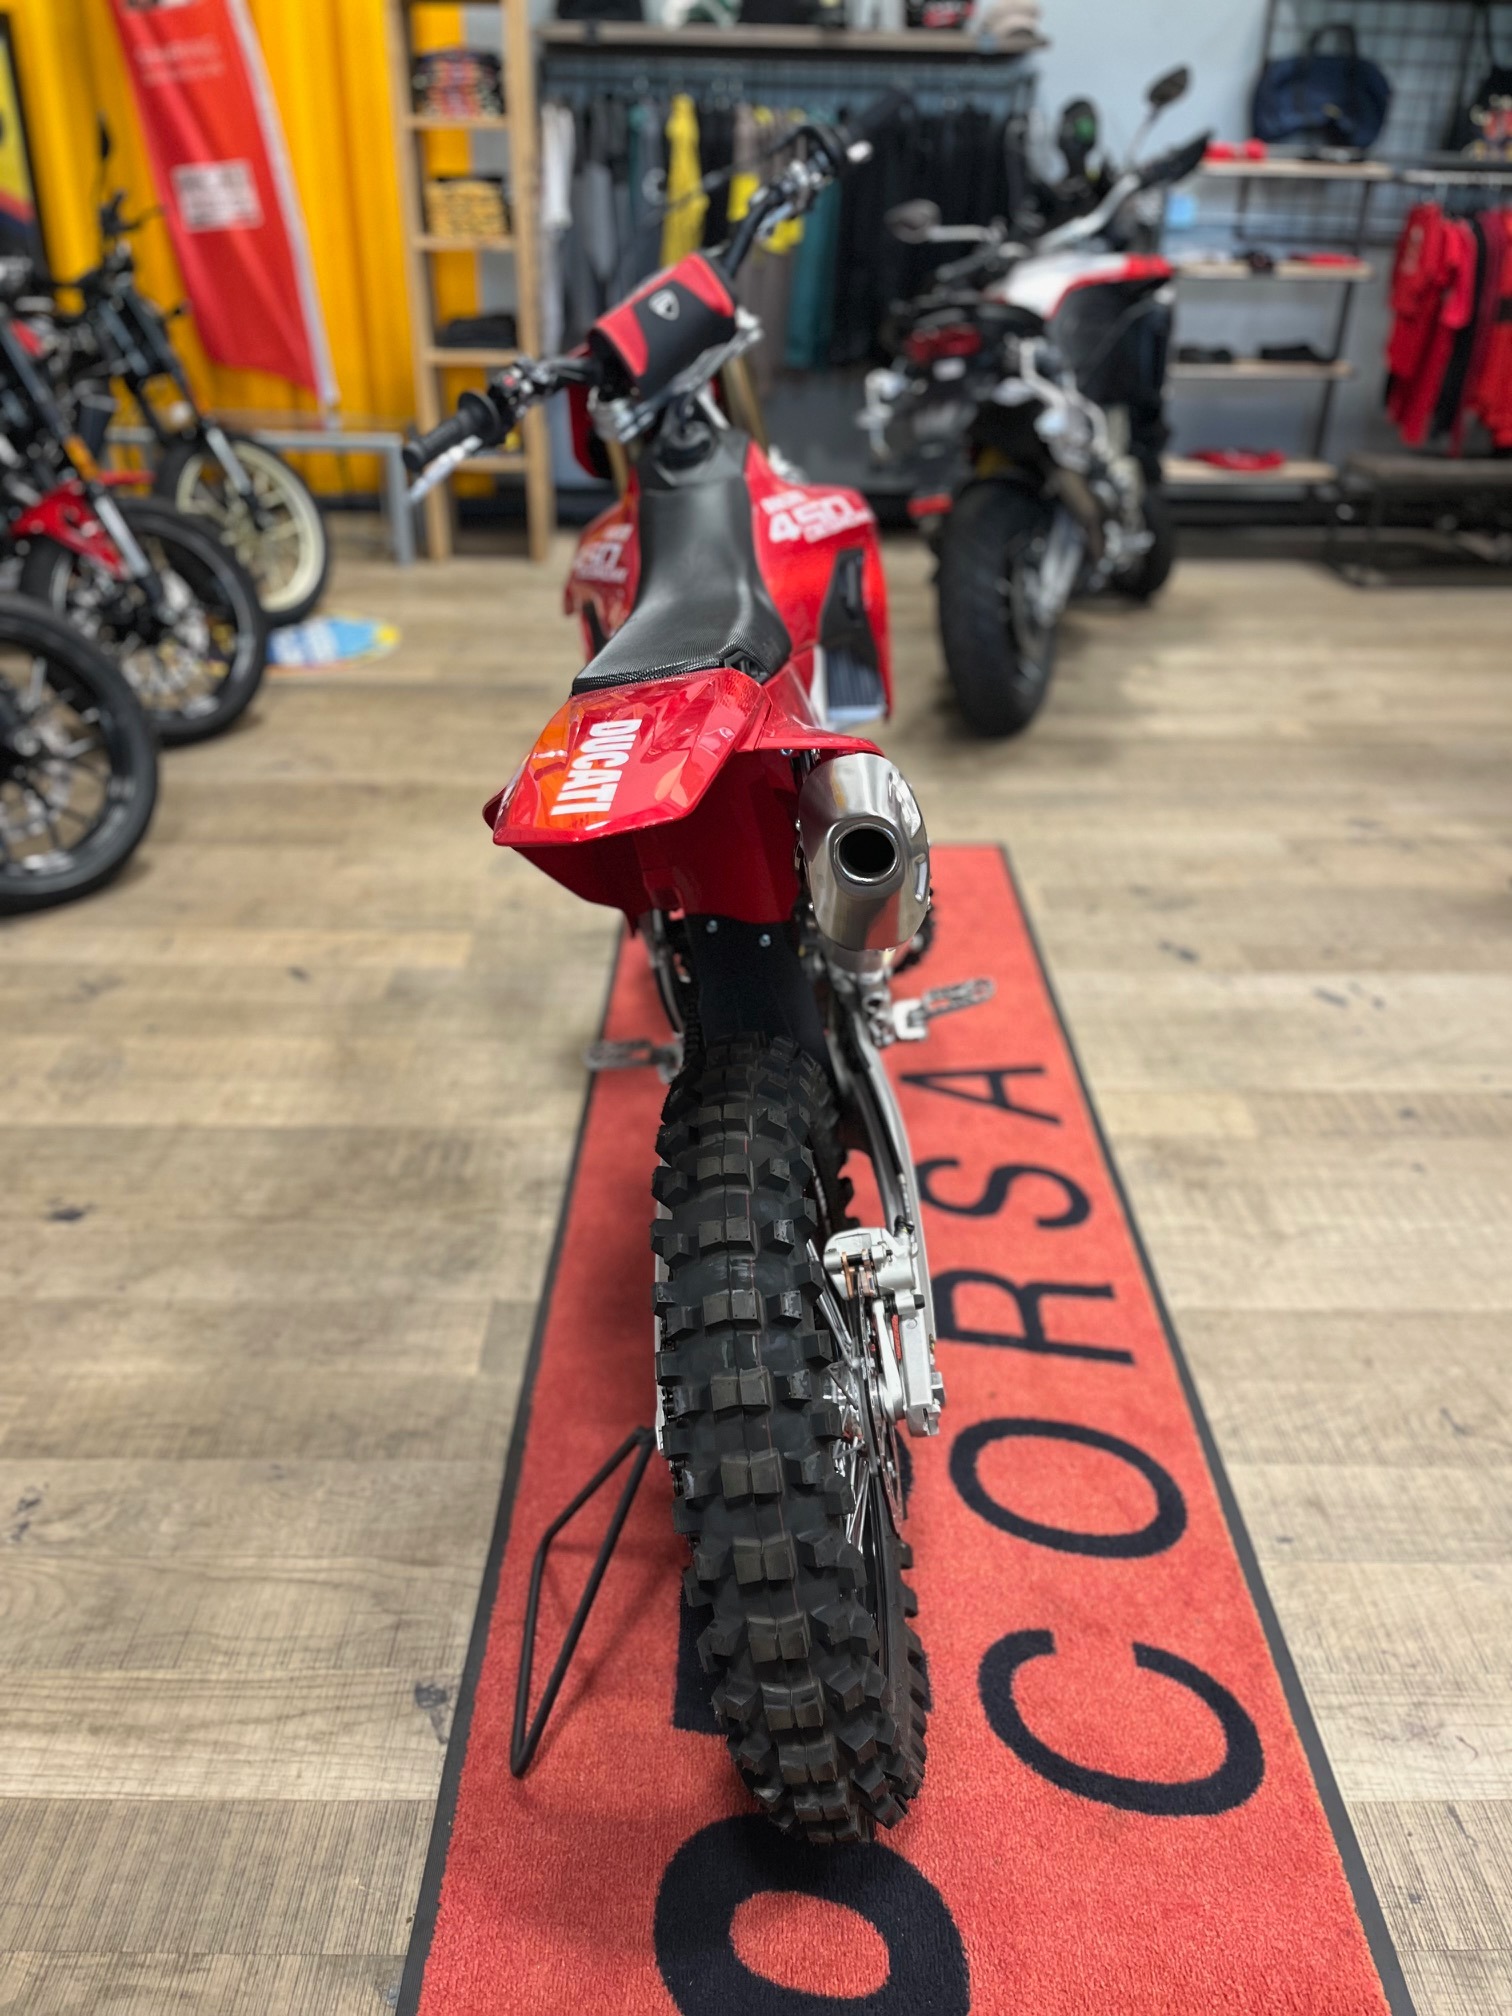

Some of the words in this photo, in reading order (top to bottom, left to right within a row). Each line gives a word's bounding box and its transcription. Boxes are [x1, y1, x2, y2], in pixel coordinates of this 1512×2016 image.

[769, 494, 854, 542] 450
[551, 718, 642, 816] DUCATI
[900, 1065, 1265, 1817] CORSA
